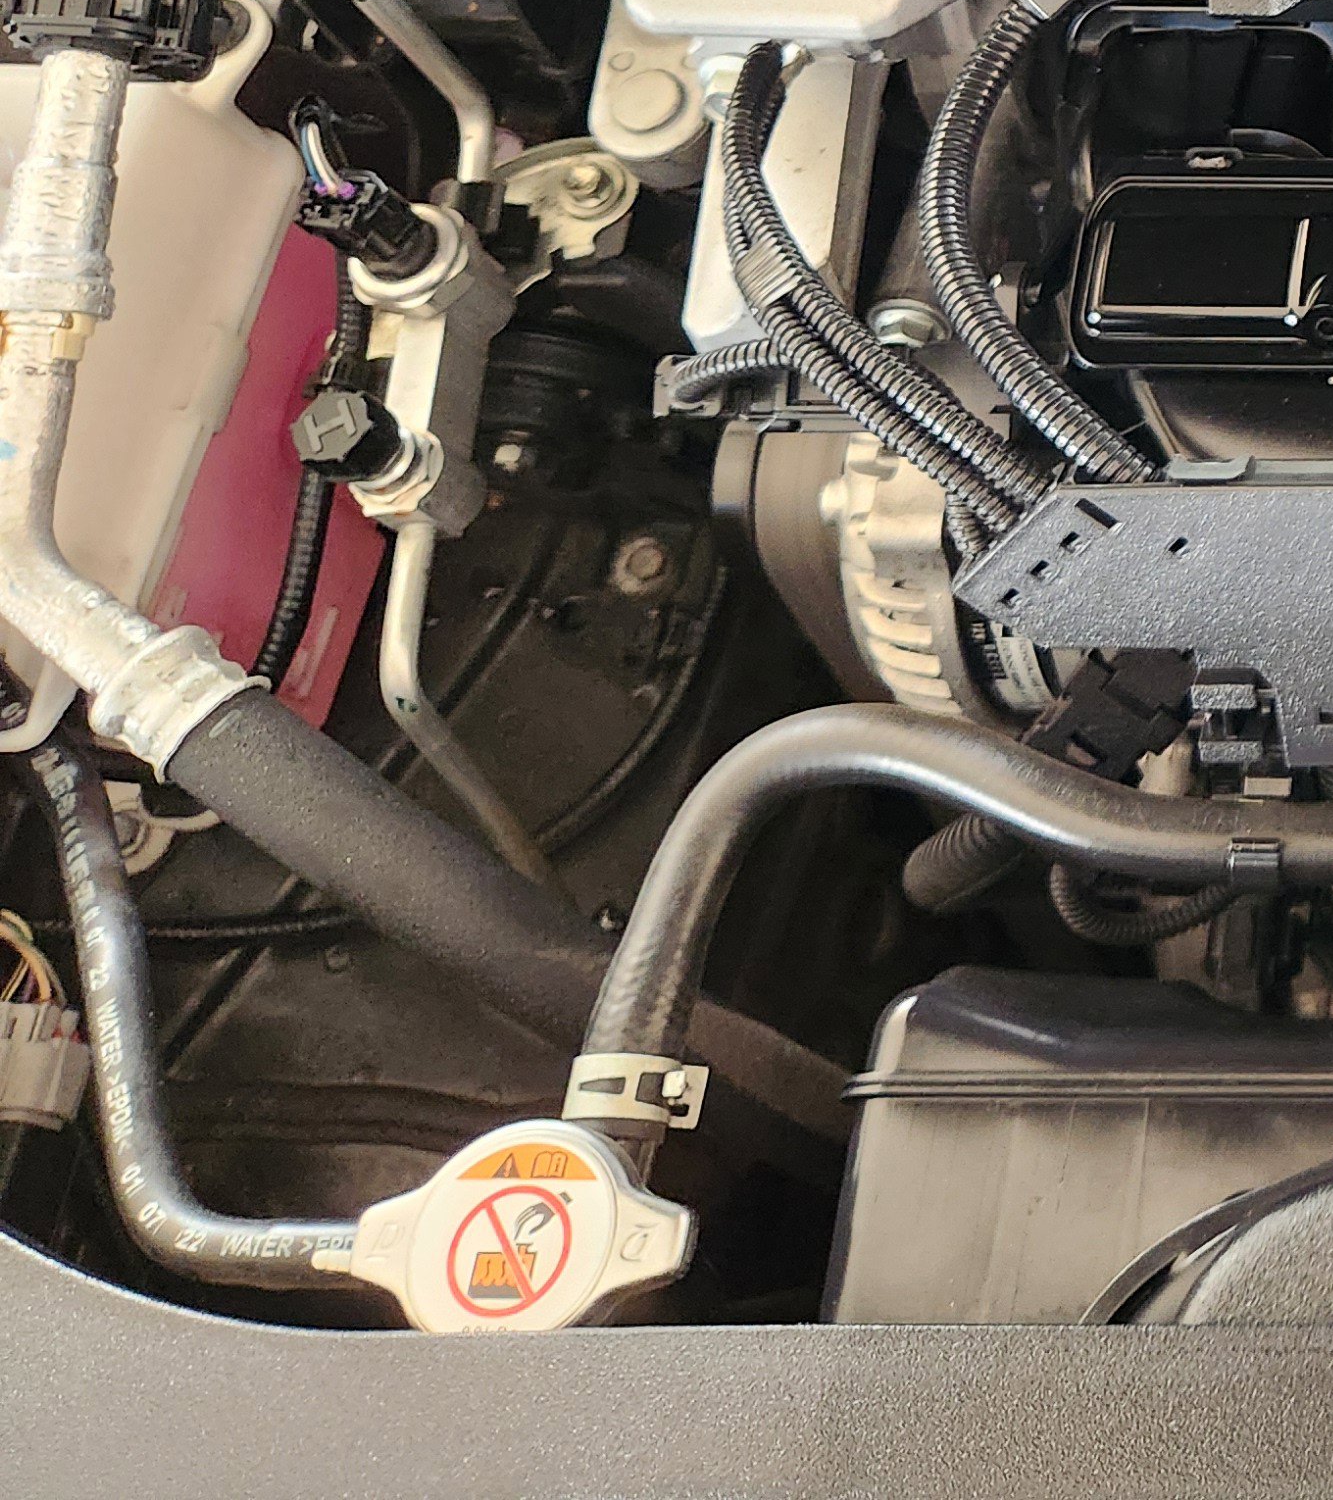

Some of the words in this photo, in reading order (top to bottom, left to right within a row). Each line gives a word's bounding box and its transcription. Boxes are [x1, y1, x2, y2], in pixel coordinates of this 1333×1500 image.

[303, 397, 357, 455] H
[95, 997, 124, 1073] WATER
[219, 1234, 296, 1258] WATER
